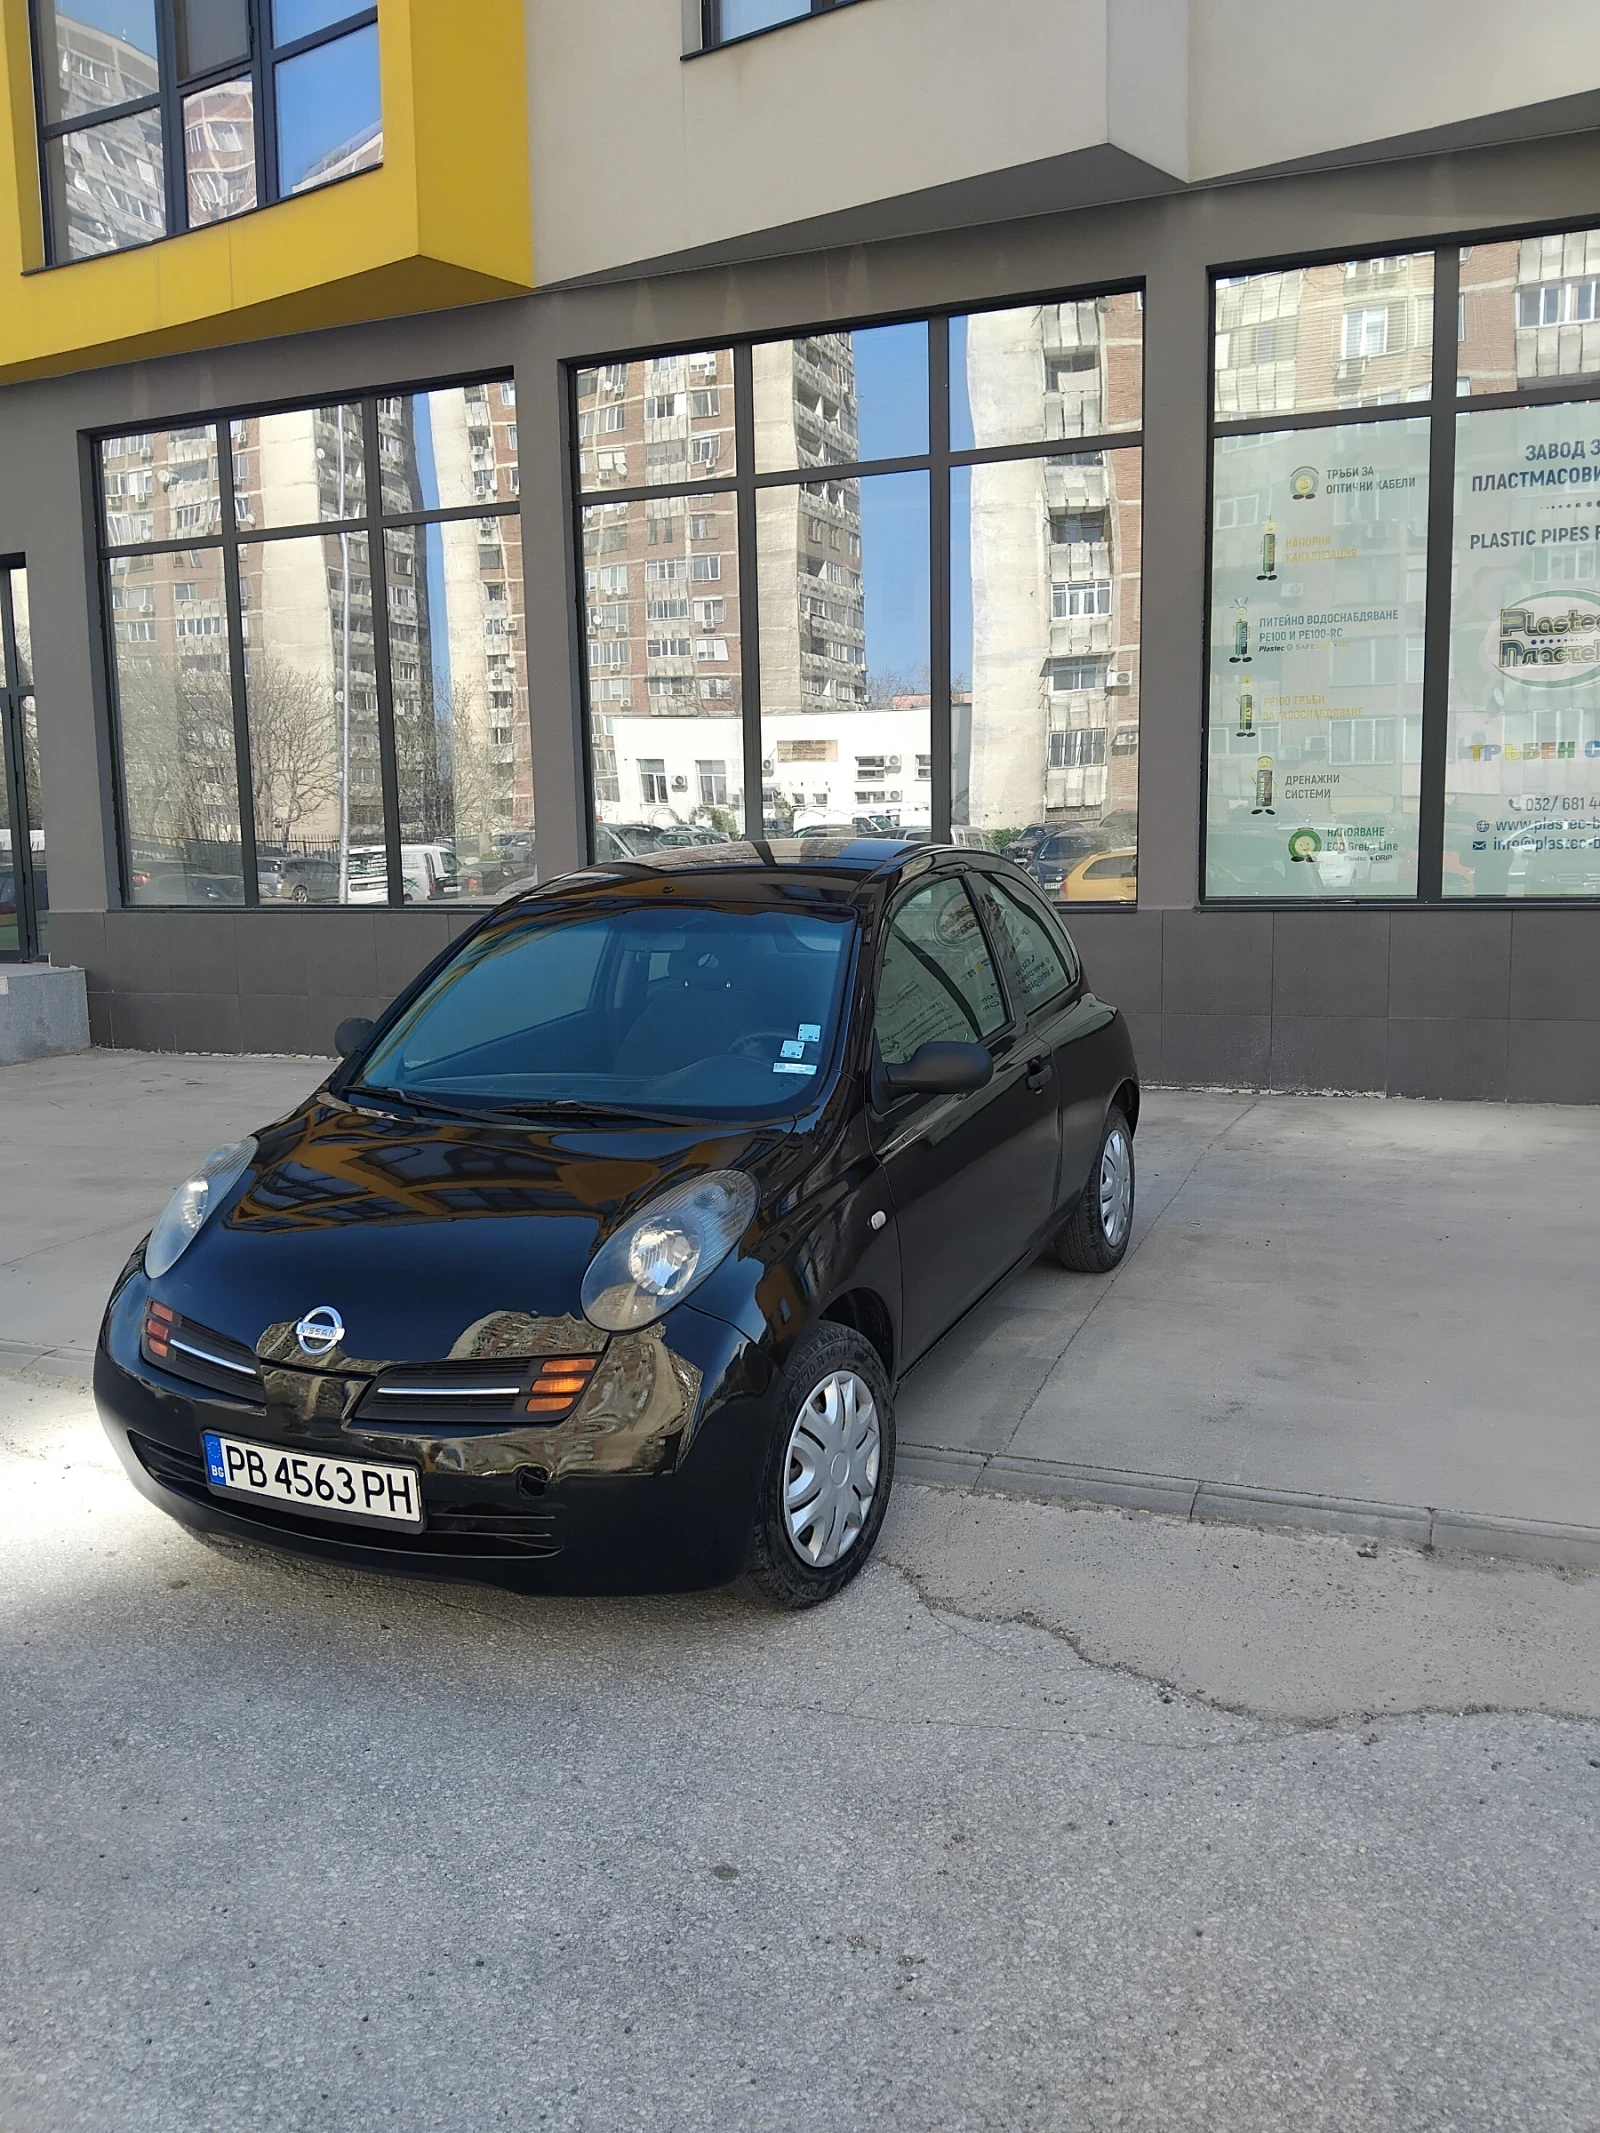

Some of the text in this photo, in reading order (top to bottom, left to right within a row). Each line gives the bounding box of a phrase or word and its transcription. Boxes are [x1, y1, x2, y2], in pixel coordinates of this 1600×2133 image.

[1525, 440, 1585, 461] ЗАВОД
[1326, 465, 1374, 480] ТРЪБИ ЗА
[1326, 476, 1416, 495] ОПТИЧНИ КАБЕЛИ
[1286, 535, 1331, 549] НАПОРНА
[1470, 530, 1536, 550] PLASTIC
[1541, 525, 1590, 544] PIPES
[1285, 549, 1357, 564] КАНАЛИЗАЦИЯ
[1259, 609, 1399, 629] ПИТЕЙНО ВОДОСНАБДЯВАНЕ
[1259, 627, 1343, 642] PE100 И PE100-RC
[1259, 643, 1285, 653] Plastec
[1264, 694, 1325, 707] PE100 ТРЪБИ
[1263, 707, 1364, 721] ЗА ГАЗОСНАБДЯВАНЕ
[1469, 741, 1576, 762] ТРЪБЕН
[1285, 774, 1340, 787] ДРЕНАЖНИ
[1285, 788, 1331, 800] СИСТЕМИ
[1525, 795, 1558, 812] 032/
[1562, 797, 1585, 811] 681
[1327, 826, 1385, 838] НАПОЯВАНЕ
[1496, 817, 1600, 833] www.plasec-b
[1378, 841, 1398, 852] Line
[1375, 854, 1393, 862] DRIP
[298, 1324, 338, 1338] NISSAN
[211, 1464, 224, 1478] BG
[226, 1445, 412, 1514] PB 4563 PH
